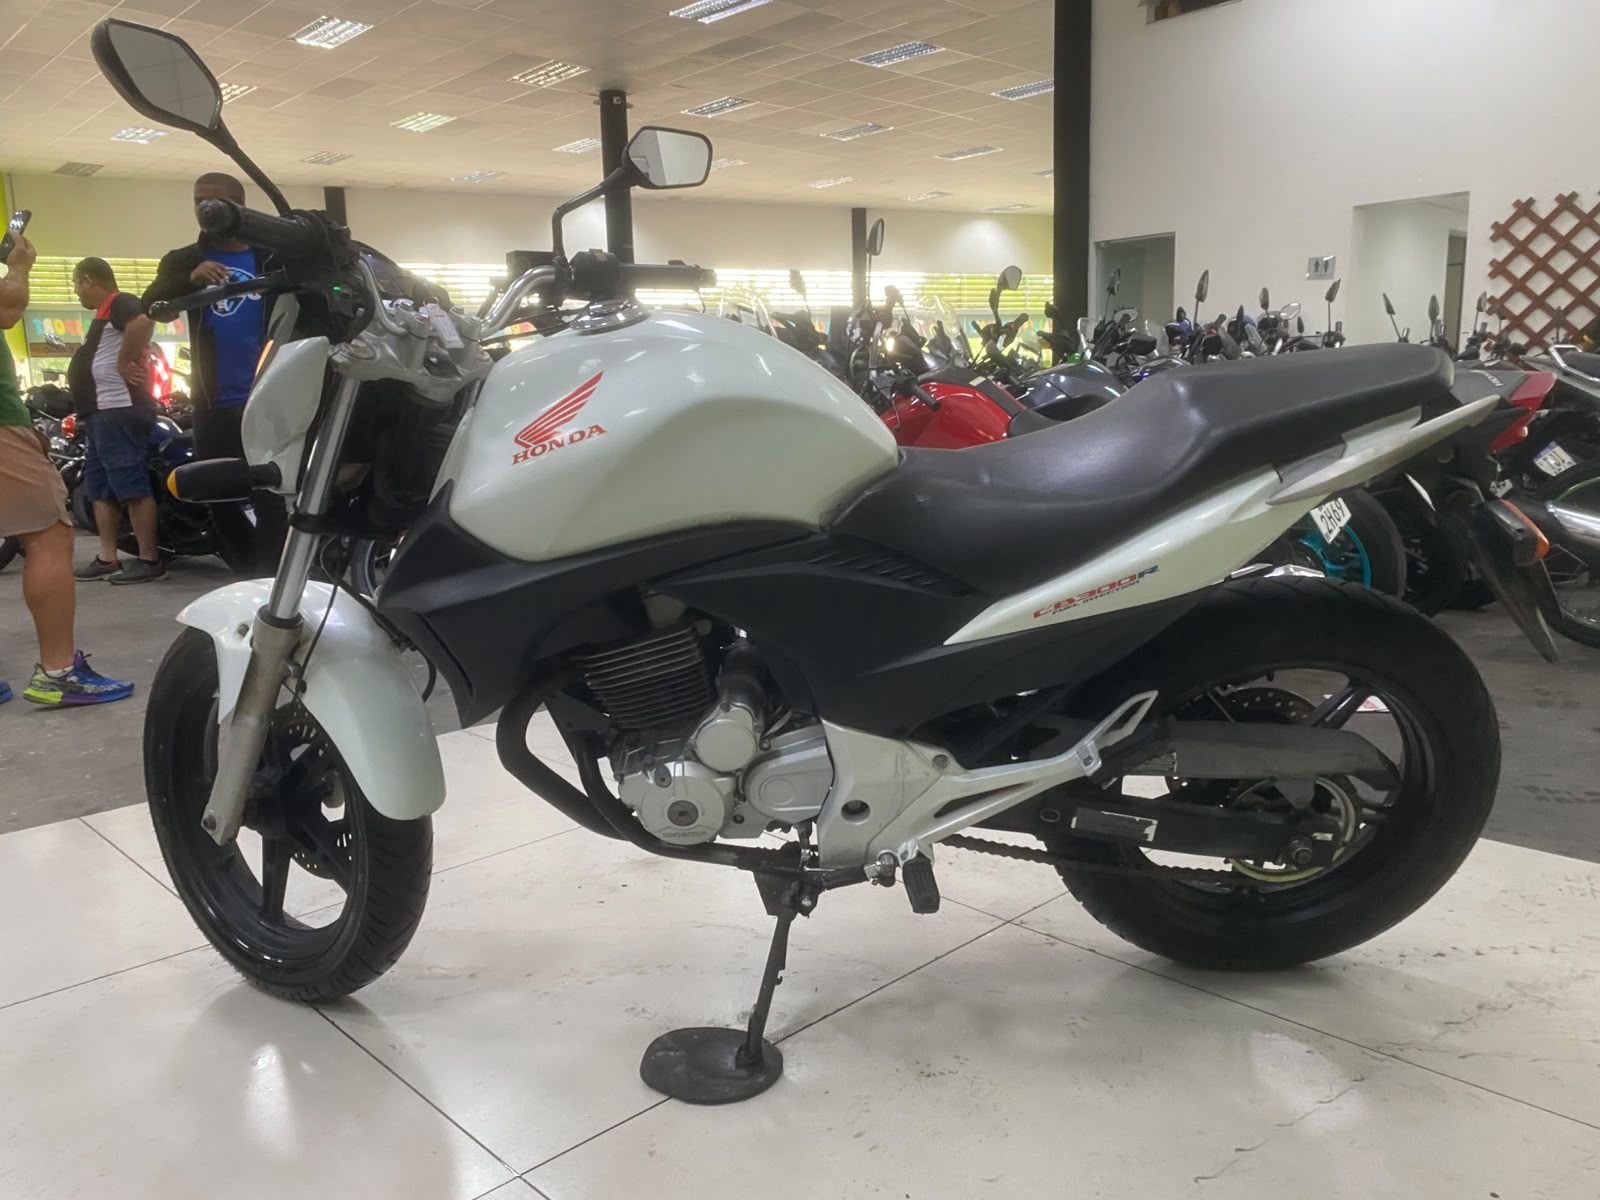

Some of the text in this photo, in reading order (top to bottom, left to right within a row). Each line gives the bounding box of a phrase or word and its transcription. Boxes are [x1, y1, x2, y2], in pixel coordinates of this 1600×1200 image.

[512, 424, 608, 465] HONDA
[1320, 499, 1346, 534] 2H69
[1033, 565, 1158, 618] CB300R
